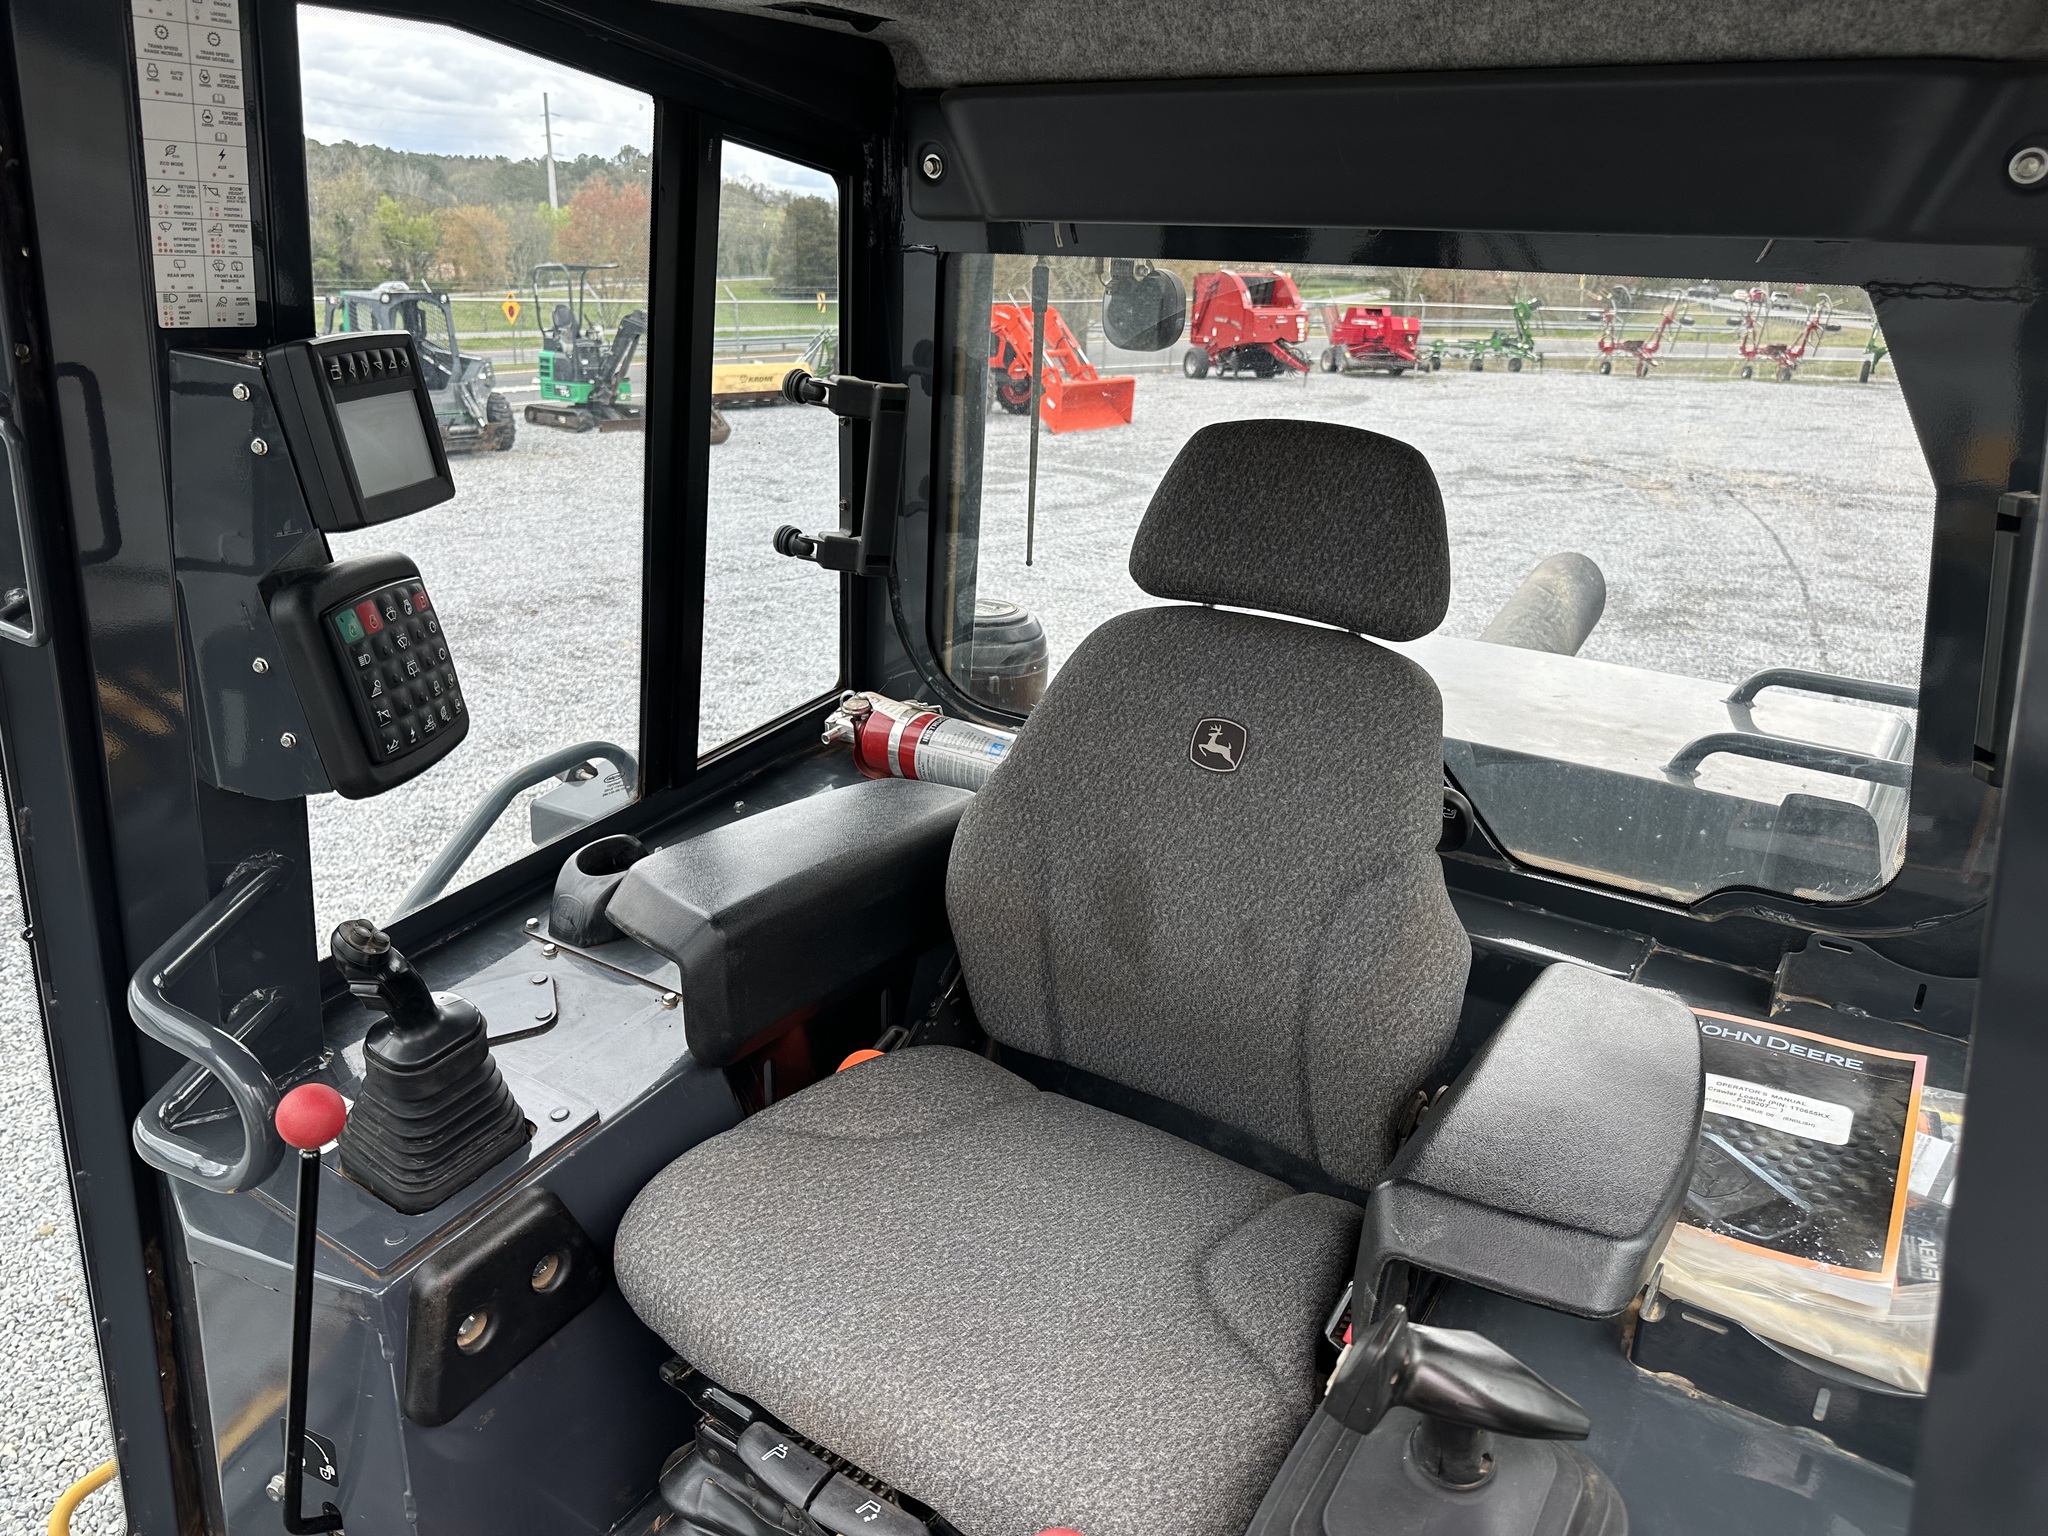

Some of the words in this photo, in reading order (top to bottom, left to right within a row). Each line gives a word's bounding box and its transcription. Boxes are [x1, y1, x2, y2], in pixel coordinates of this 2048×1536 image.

[212, 56, 235, 64] DECREASE
[748, 375, 774, 383] KRONE
[1766, 1036, 1864, 1071] DEERE
[1707, 1086, 1737, 1097] Crawler
[1739, 1093, 1767, 1103] Loader
[1716, 1081, 1768, 1097] OPERATOR'S
[1770, 1094, 1807, 1107] MANUAL
[1744, 1106, 1764, 1115] ISSUE
